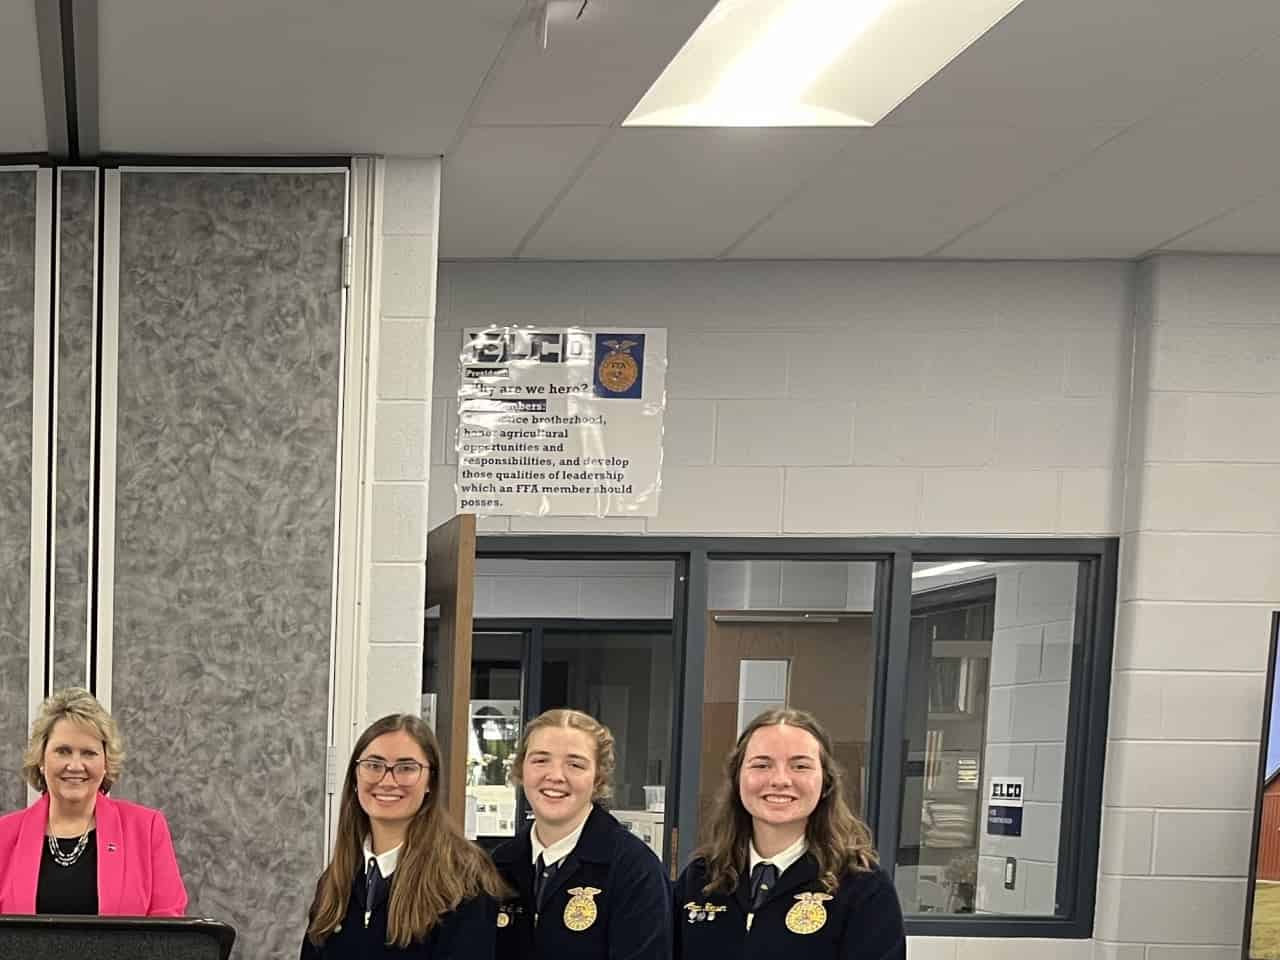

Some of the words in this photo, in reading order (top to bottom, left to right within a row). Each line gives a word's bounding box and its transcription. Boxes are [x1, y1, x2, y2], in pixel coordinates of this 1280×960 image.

[526, 386, 545, 394] we
[549, 383, 589, 395] here?
[531, 415, 607, 425] brotherhood,
[543, 443, 564, 452] and
[560, 457, 580, 466] and
[462, 470, 493, 479] those
[496, 470, 546, 481] qualities
[548, 471, 560, 479] of
[562, 471, 625, 482] leadership
[461, 484, 496, 493] which
[499, 485, 513, 493] an
[516, 484, 538, 493] FFA
[542, 485, 591, 494] member
[461, 499, 503, 509] posses.
[992, 783, 1021, 798] ELCO
